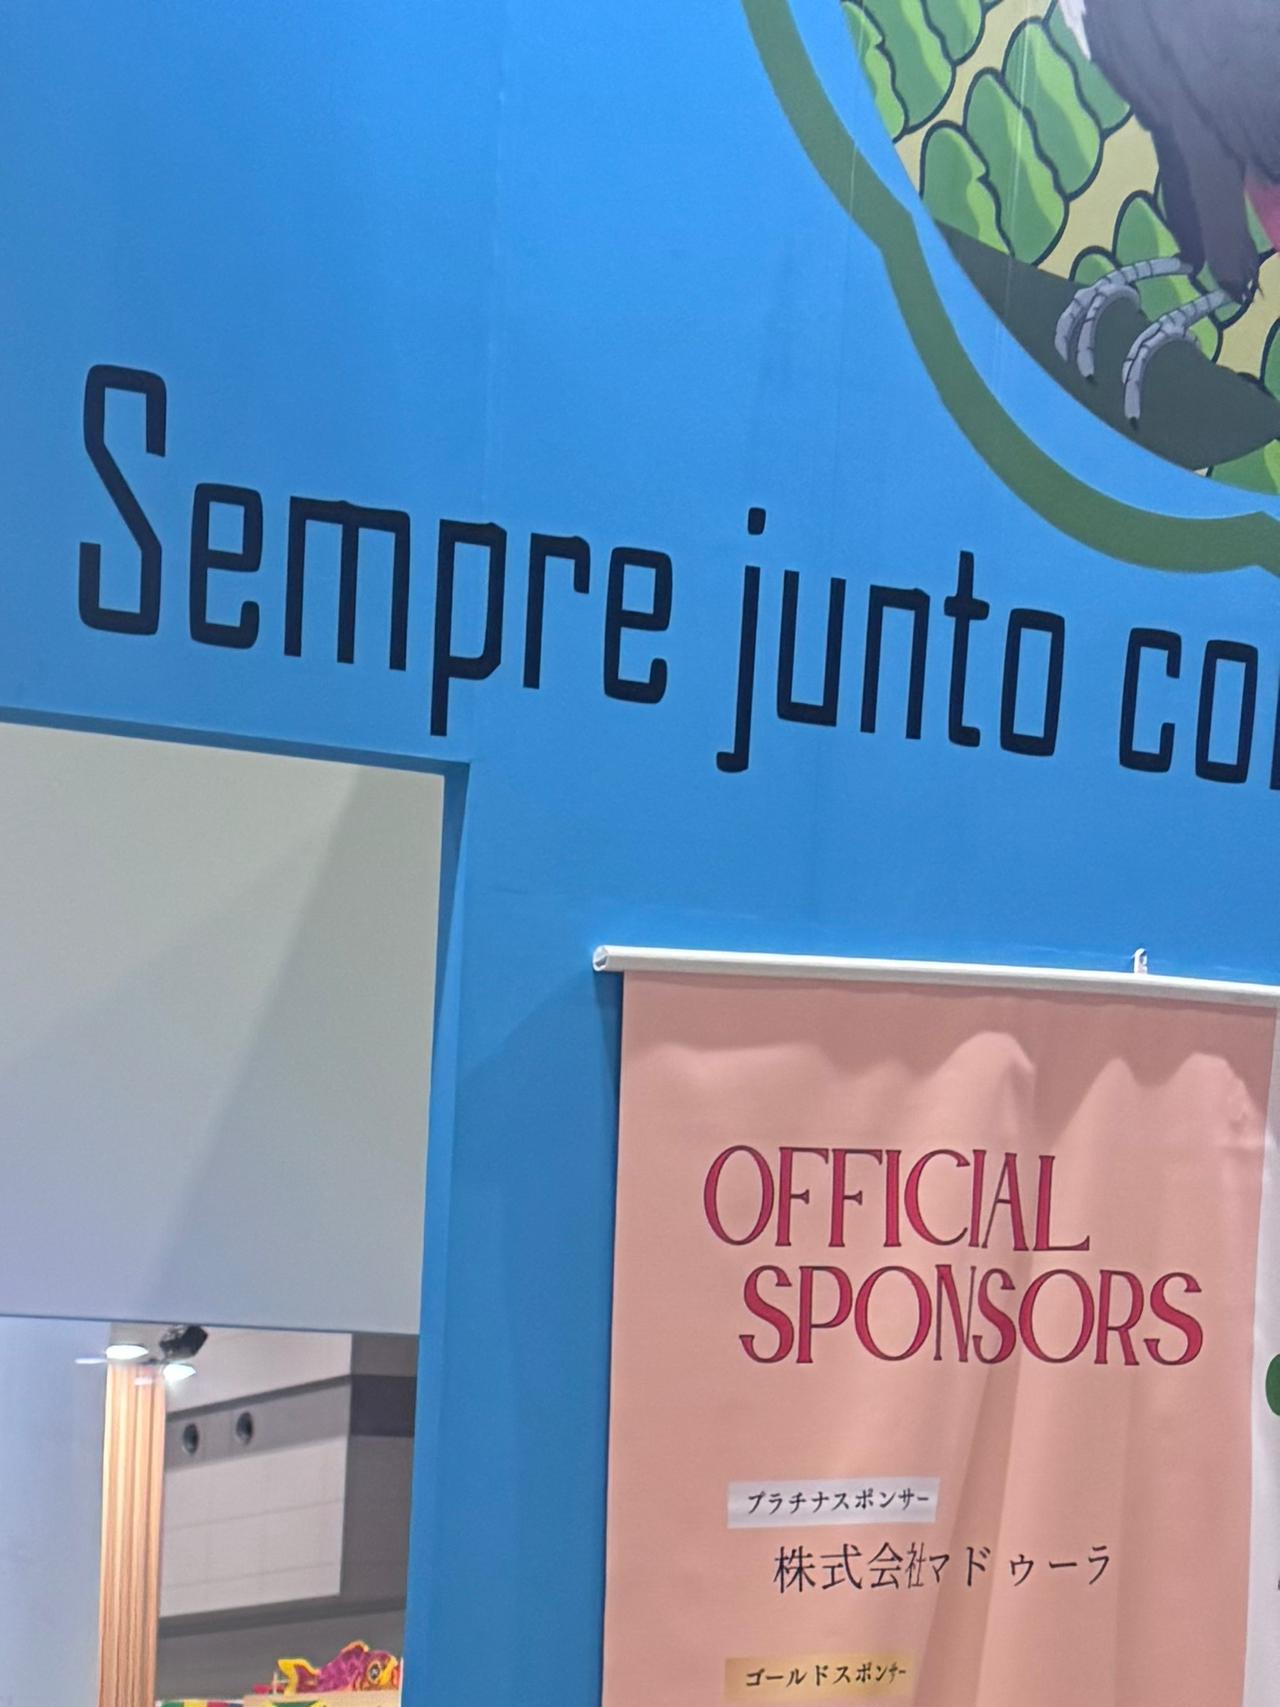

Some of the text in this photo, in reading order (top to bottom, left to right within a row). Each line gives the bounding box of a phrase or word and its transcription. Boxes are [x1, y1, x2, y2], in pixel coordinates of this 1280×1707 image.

[78, 363, 1280, 791] Sempre junto co
[704, 1145, 1090, 1252] OFFICIAL
[740, 1264, 1204, 1366] SPONSORS
[748, 1487, 929, 1515] プラチナスポンサー
[773, 1541, 1111, 1594] 株式会社マドゥーラ
[746, 1661, 906, 1687] ゴールドスポンサー
